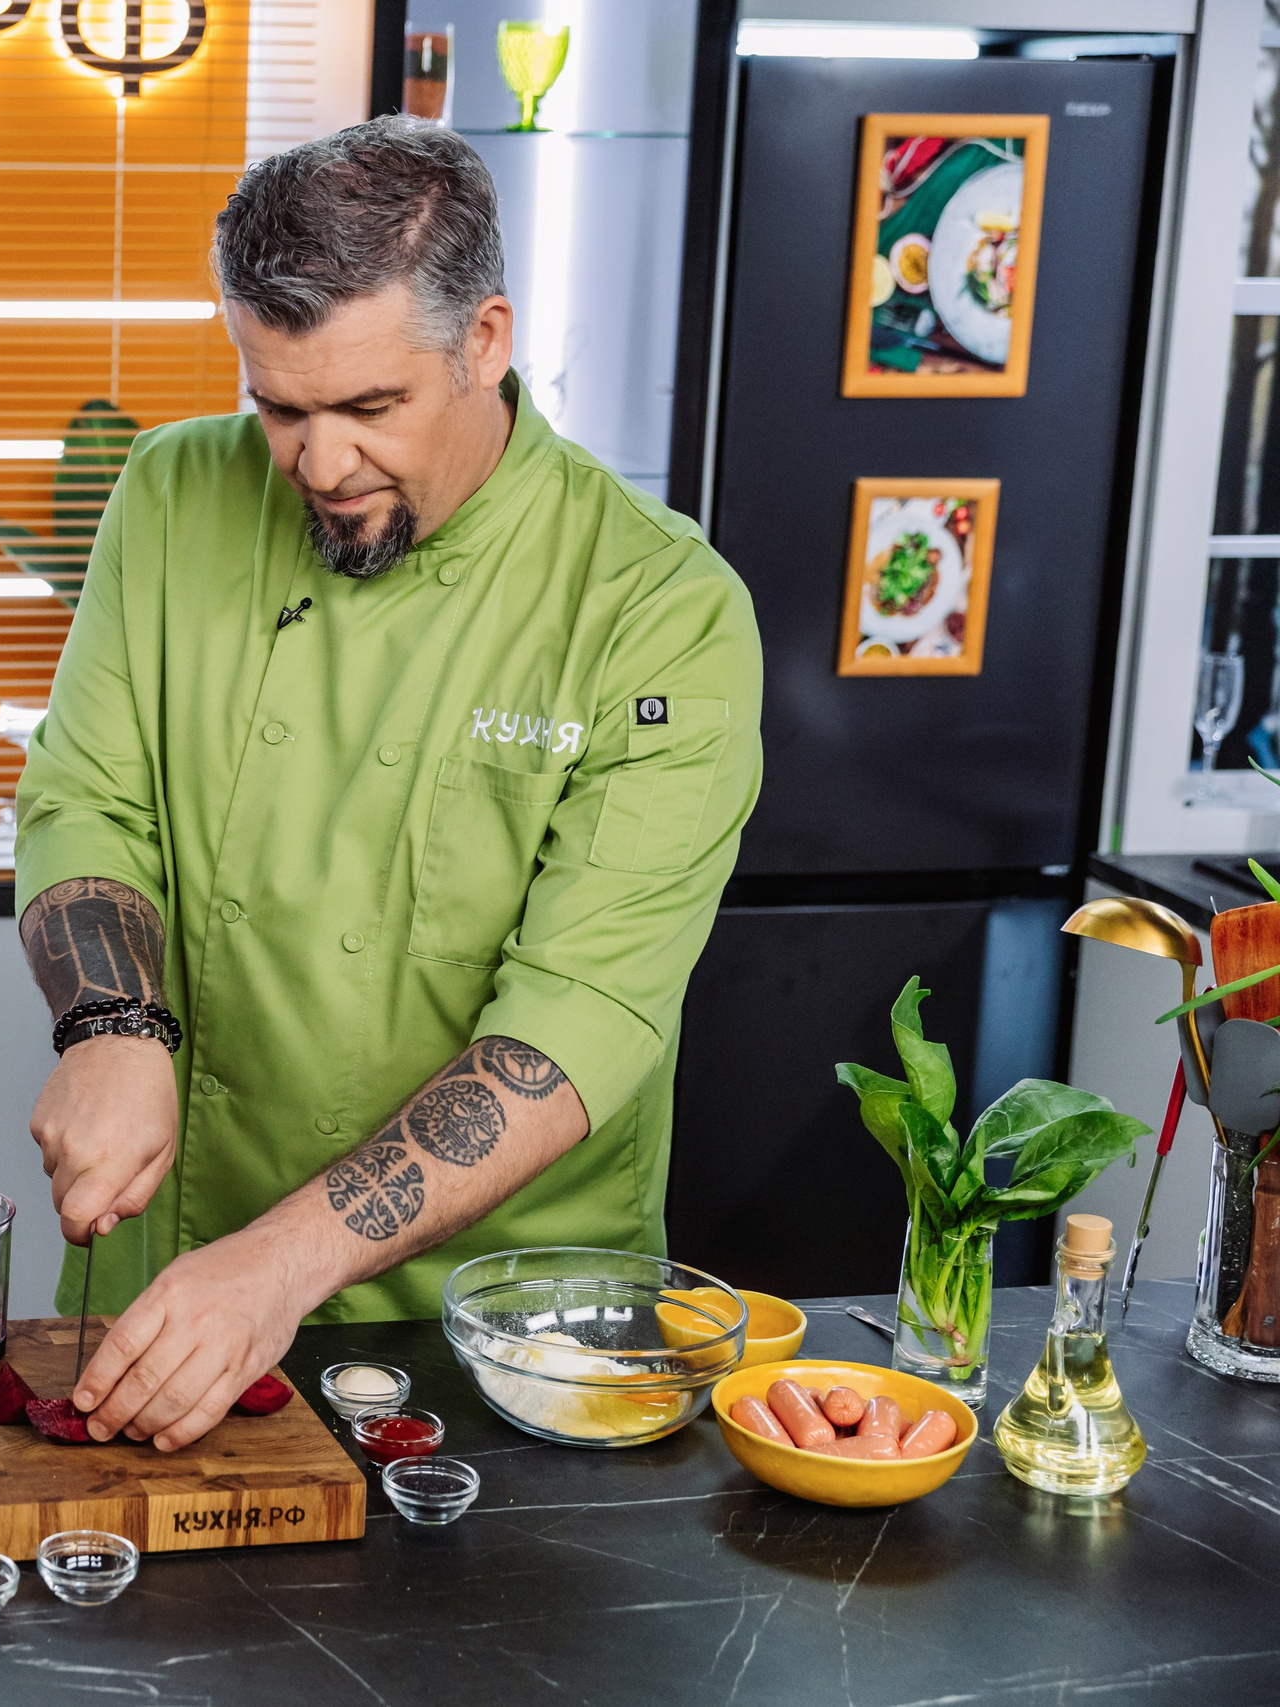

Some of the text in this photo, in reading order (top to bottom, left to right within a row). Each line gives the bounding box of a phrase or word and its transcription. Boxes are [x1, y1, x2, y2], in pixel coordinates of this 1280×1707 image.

[470, 707, 583, 754] КУХНЯ
[88, 1016, 113, 1037] YES
[173, 1505, 306, 1534] КУХНЯ.РФ
